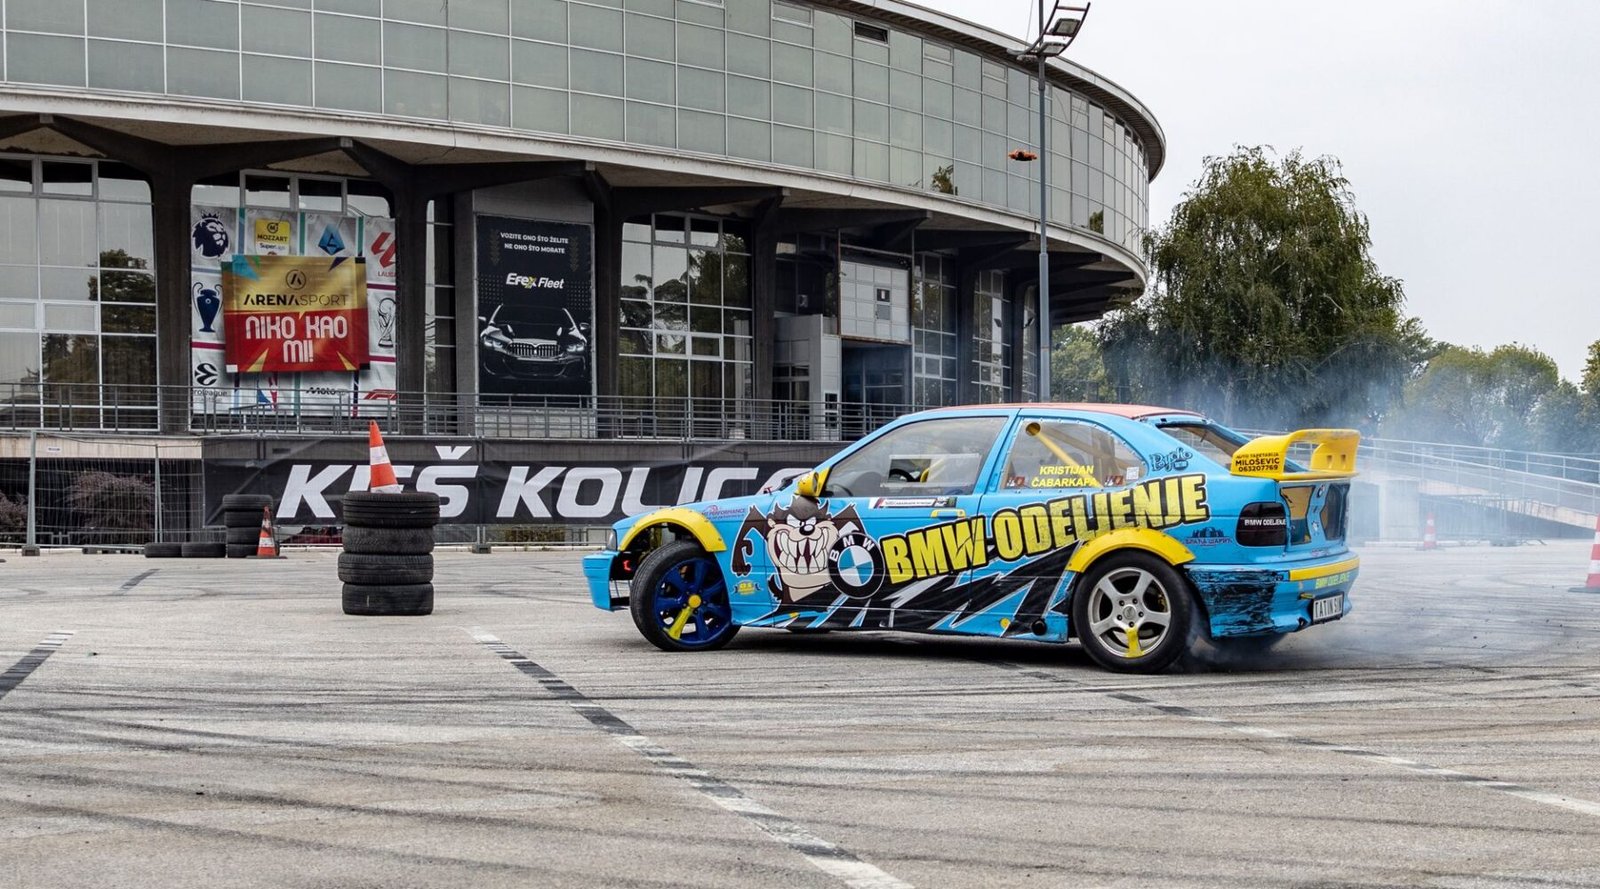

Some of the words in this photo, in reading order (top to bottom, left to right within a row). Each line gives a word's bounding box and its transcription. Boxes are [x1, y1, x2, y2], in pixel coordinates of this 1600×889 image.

[257, 234, 288, 242] MOZZART
[500, 232, 521, 240] VOZITE
[537, 235, 549, 243] ŠTO
[550, 236, 569, 244] ŽELITE
[514, 243, 527, 251] ONO
[528, 244, 540, 252] ŠTO
[541, 246, 565, 254] MORATE
[538, 277, 564, 289] Fleet
[246, 316, 295, 339] NIKO
[305, 315, 348, 339] KAO
[283, 339, 314, 363] MI!
[1039, 465, 1094, 475] KRISTIJAN
[496, 466, 813, 518] KOLIC
[829, 535, 875, 562] BMW
[882, 517, 987, 585] BMW
